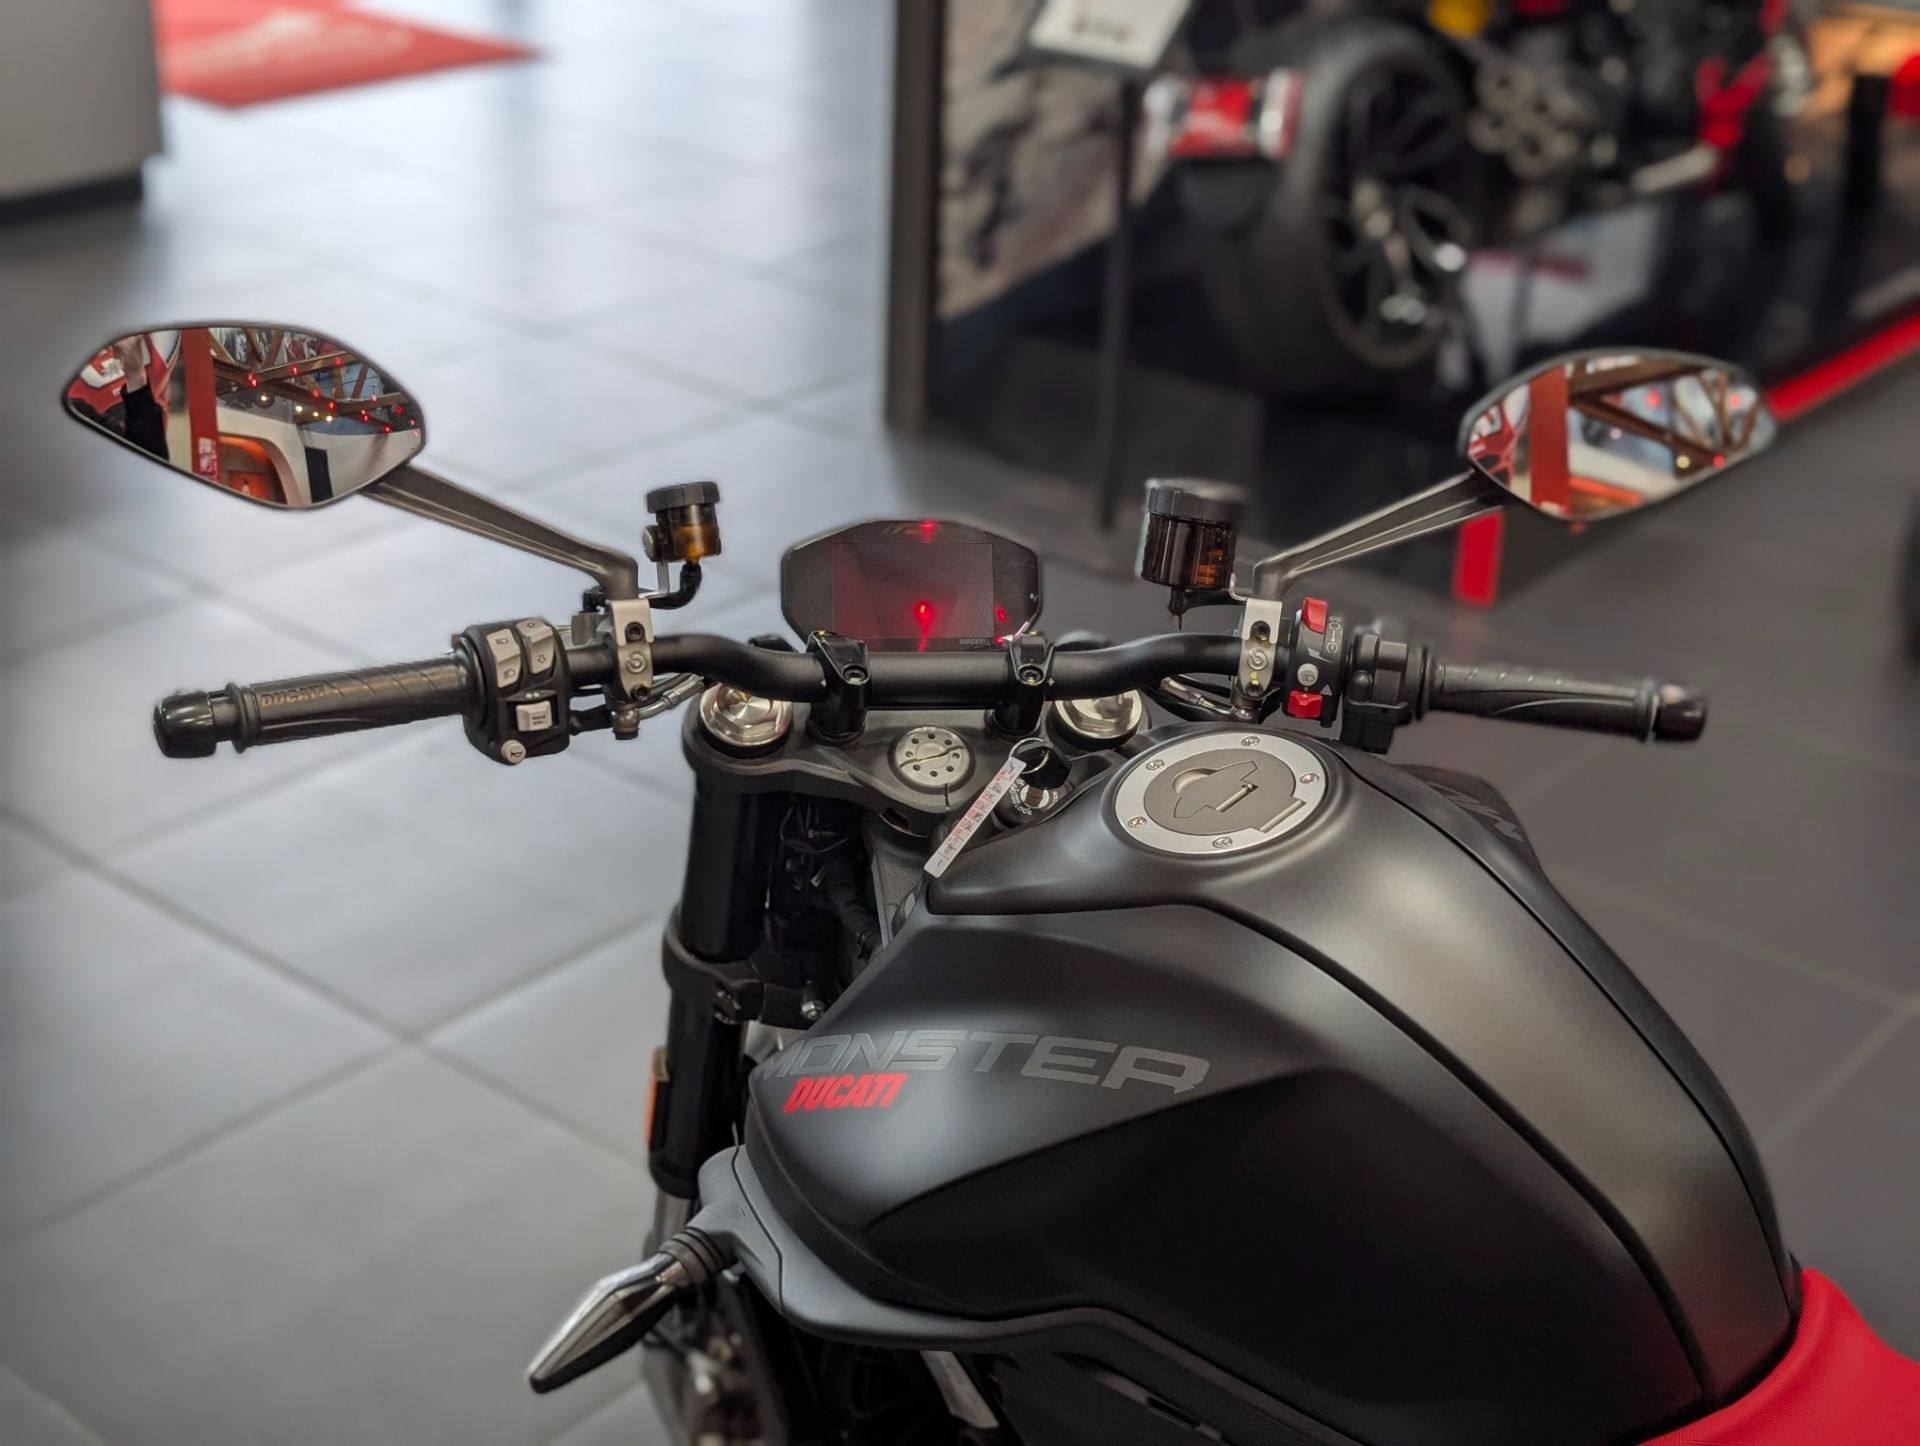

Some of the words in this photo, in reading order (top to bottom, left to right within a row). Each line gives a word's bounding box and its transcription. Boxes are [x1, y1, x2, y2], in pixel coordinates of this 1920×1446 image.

[261, 683, 326, 707] DUCATI
[757, 1029, 1211, 1094] MONSTER
[783, 1072, 909, 1114] DUCATI
